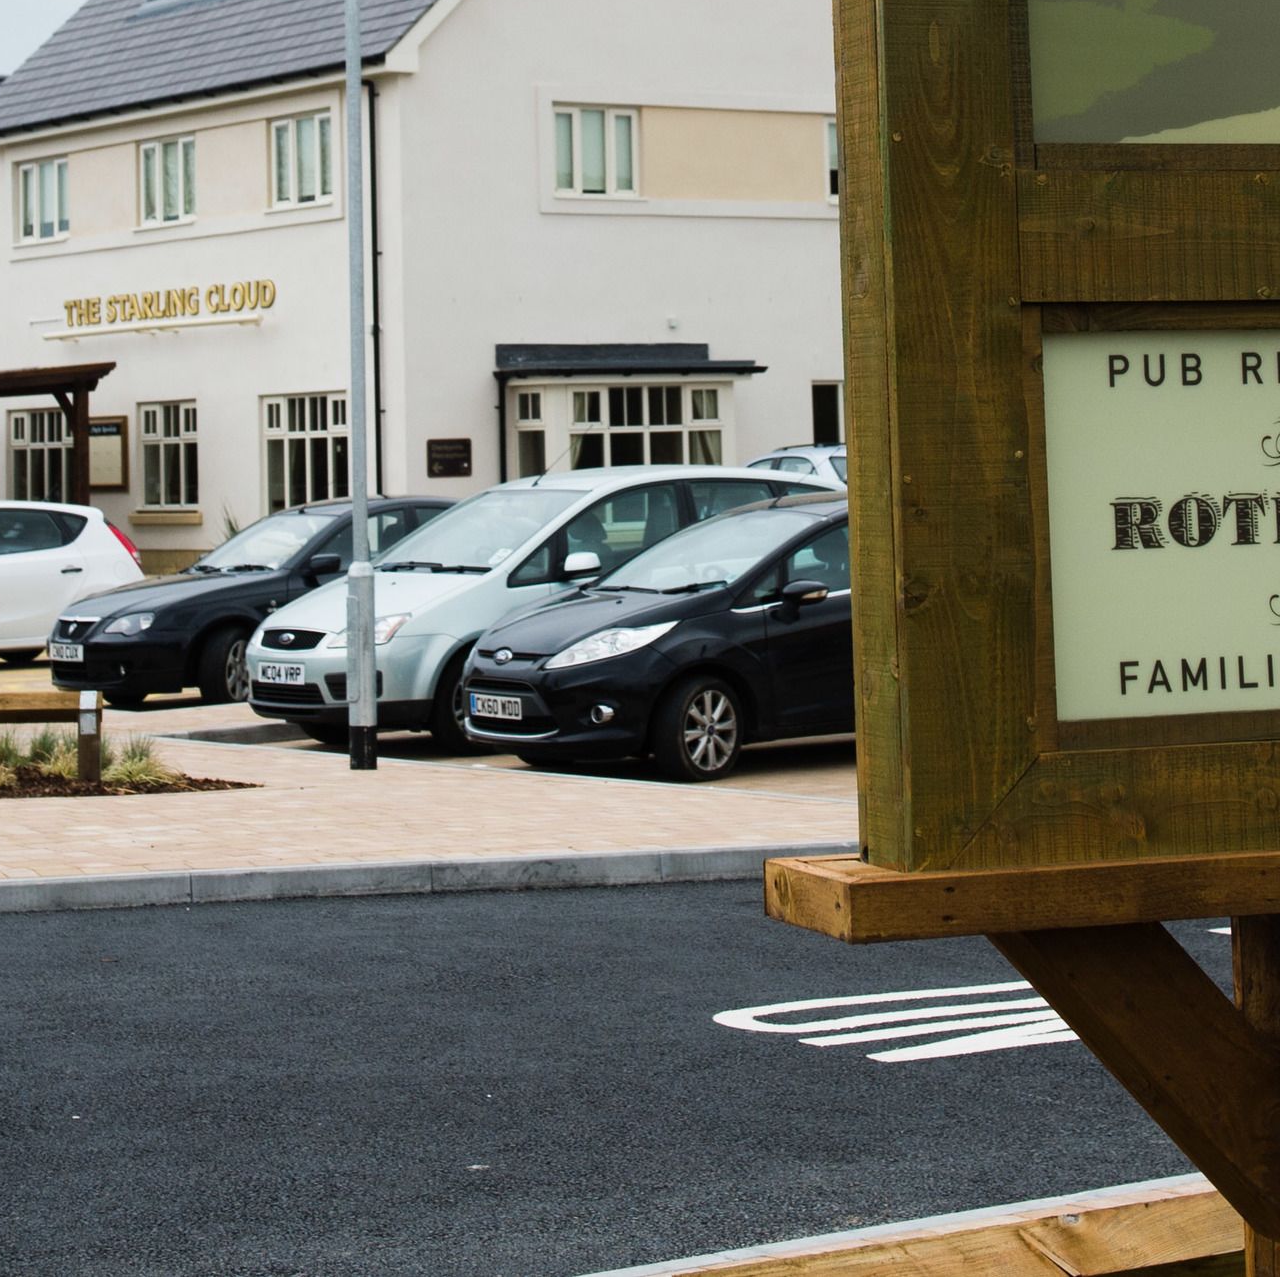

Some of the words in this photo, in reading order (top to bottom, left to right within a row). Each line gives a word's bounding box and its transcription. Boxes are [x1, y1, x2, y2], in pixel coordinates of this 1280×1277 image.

[64, 296, 102, 327] THE
[105, 286, 200, 323] STARLING
[205, 279, 277, 314] CLOUD
[1107, 352, 1205, 388] PUB
[476, 696, 499, 715] CK60
